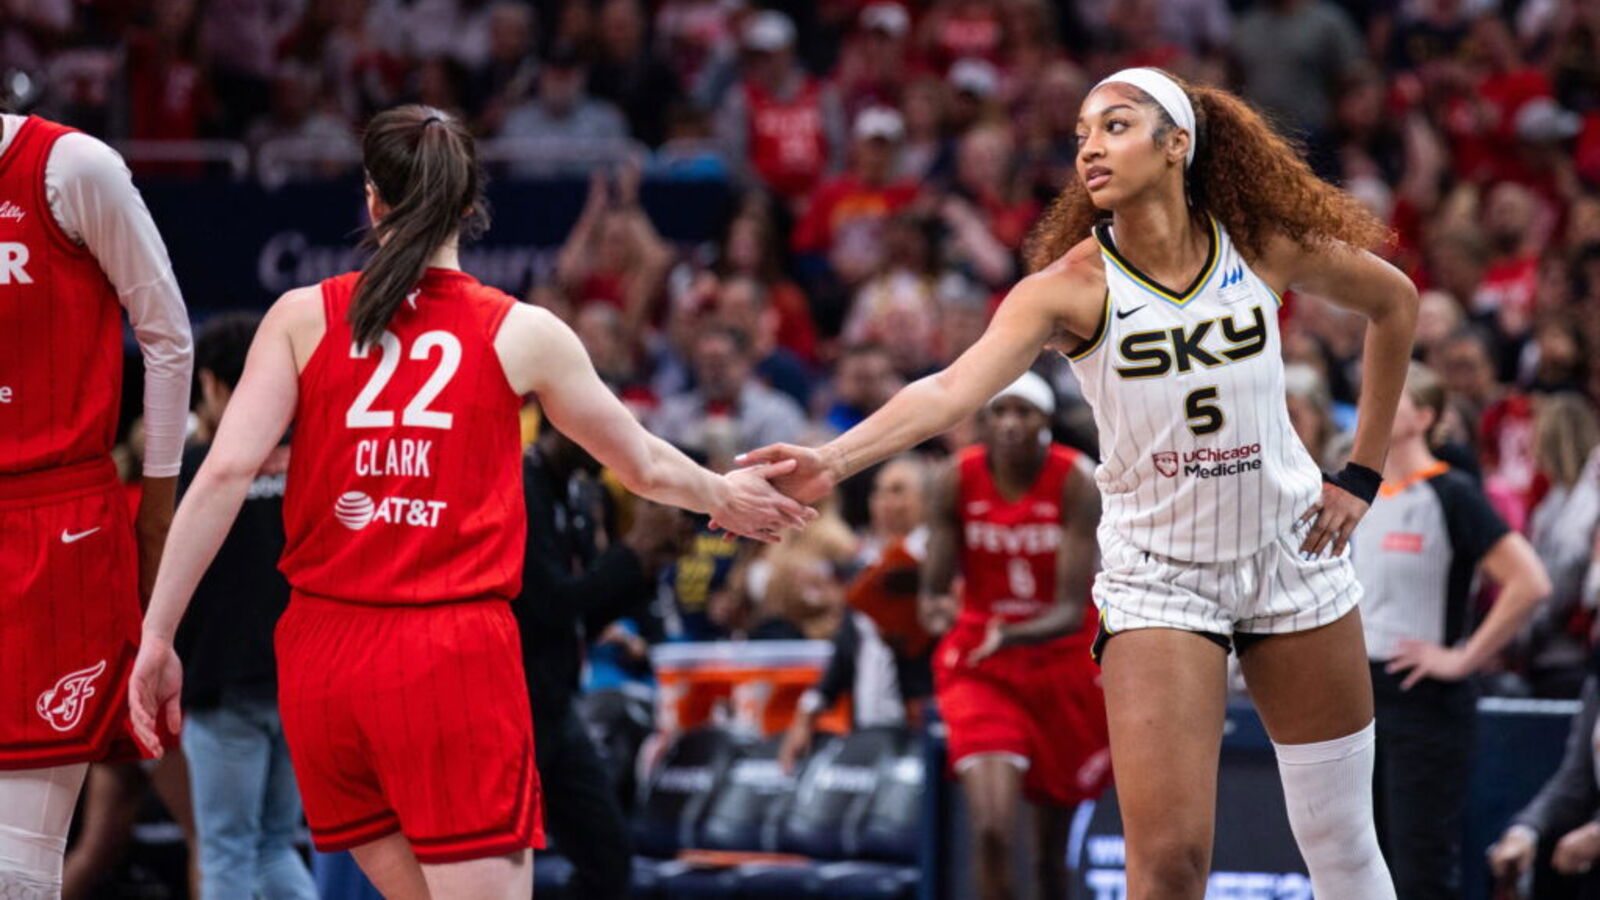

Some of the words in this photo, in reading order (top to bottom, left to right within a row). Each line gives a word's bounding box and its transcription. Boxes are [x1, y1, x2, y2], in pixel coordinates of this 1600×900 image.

[1113, 306, 1267, 379] SKY
[346, 330, 462, 430] 22
[1184, 385, 1226, 436] 5
[356, 438, 432, 477] CLARK
[1183, 443, 1261, 463] UChicago
[1184, 459, 1262, 479] Medicine
[373, 497, 448, 527] AT&T
[965, 521, 1062, 555] FEVER
